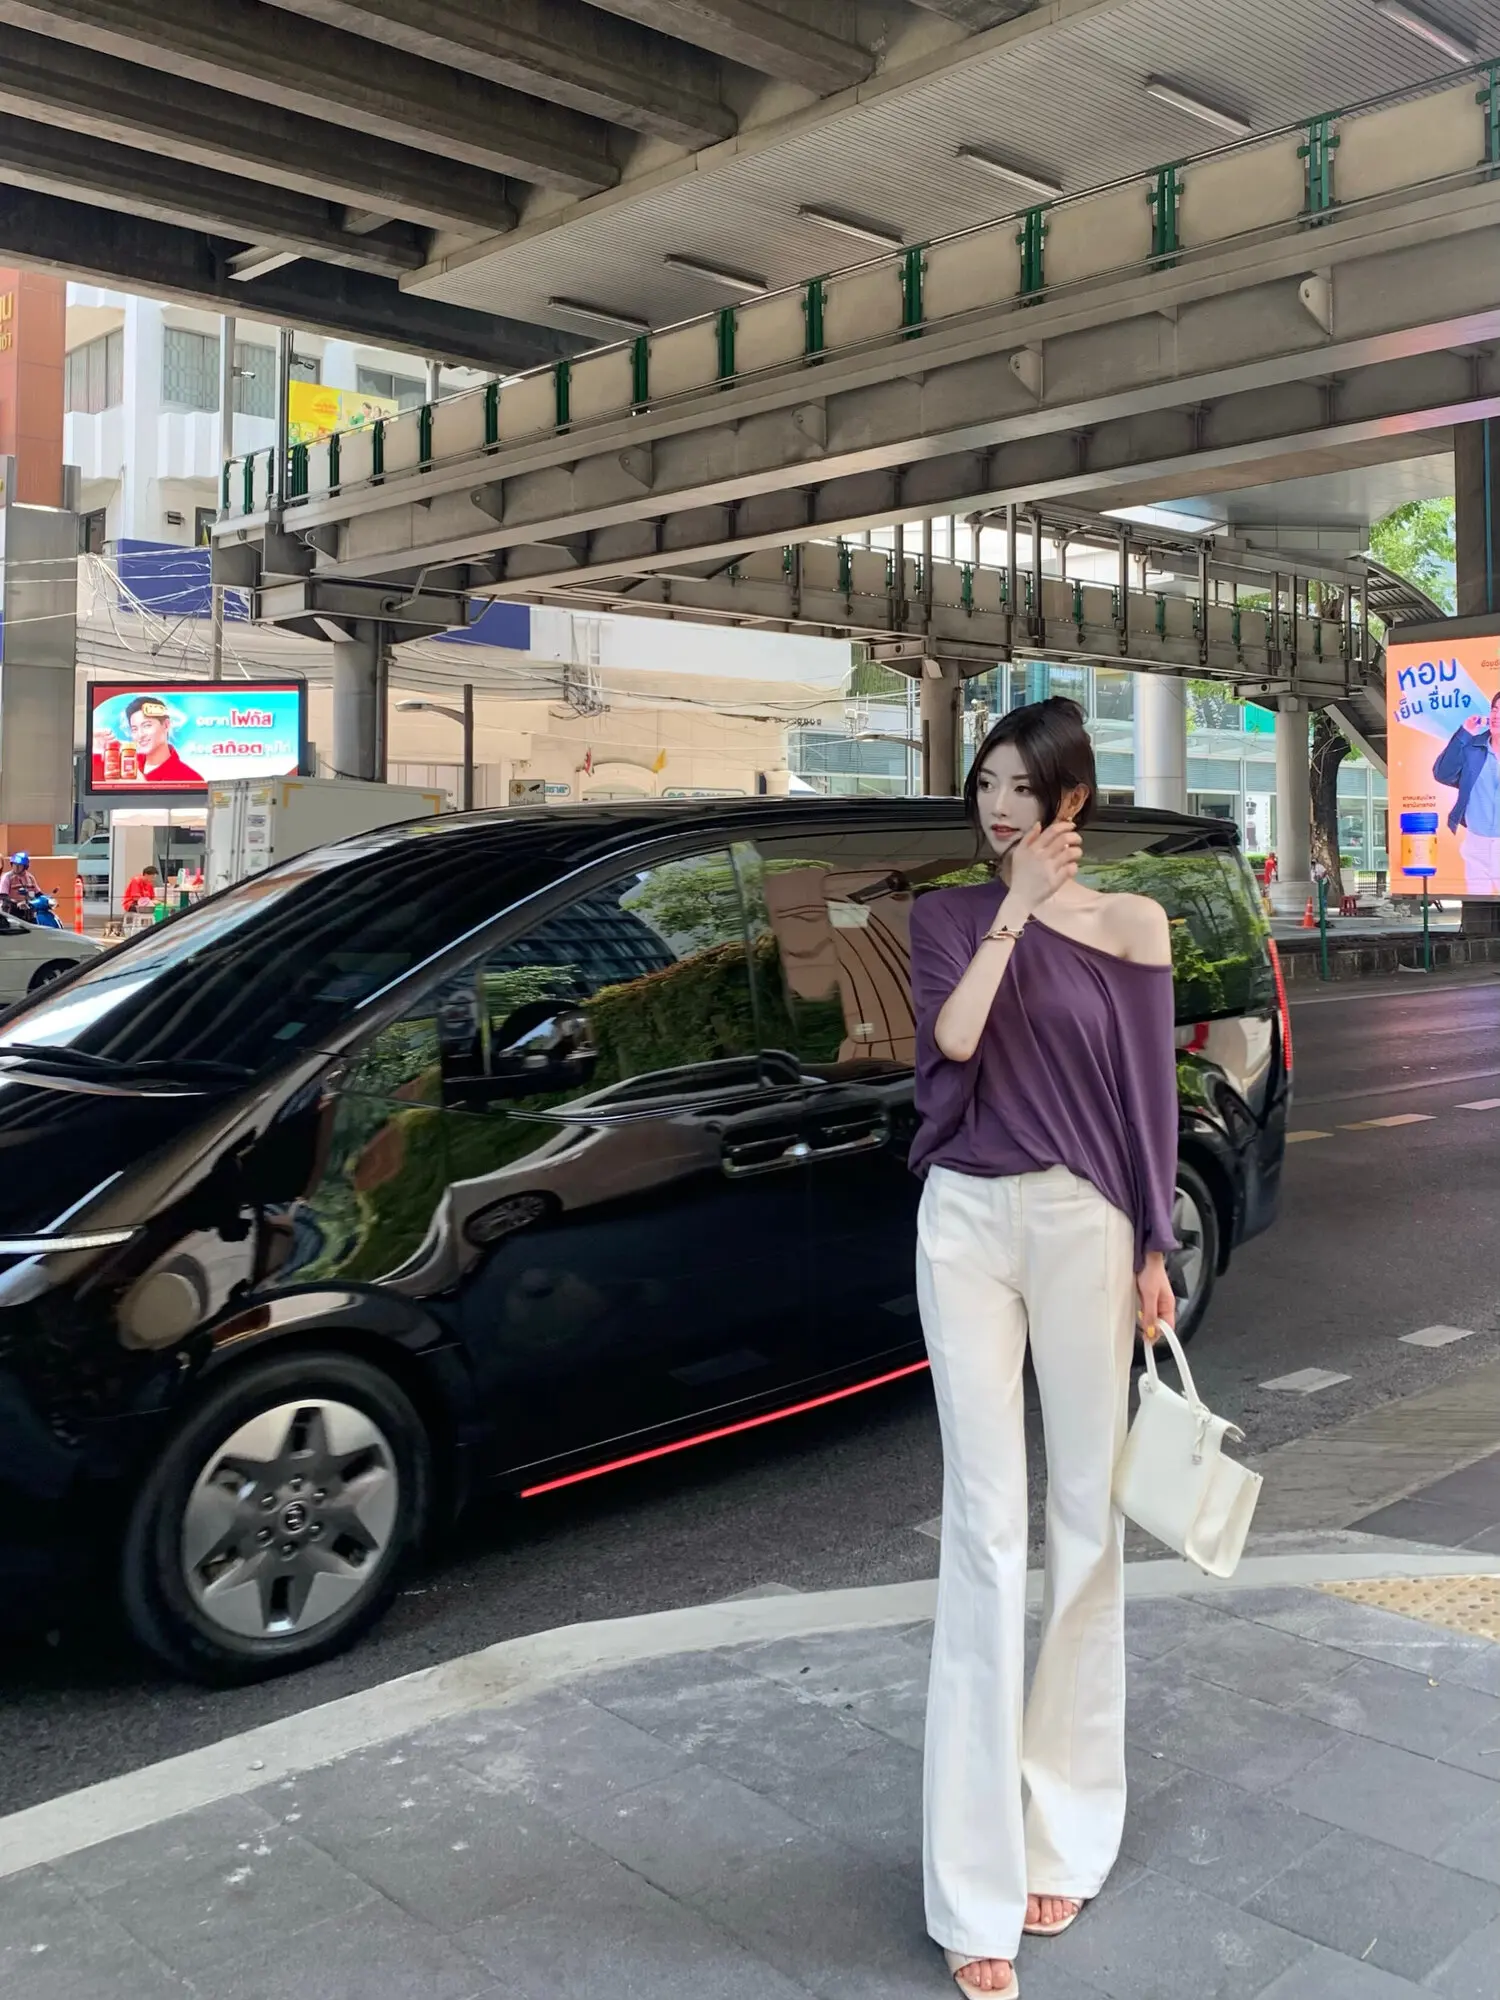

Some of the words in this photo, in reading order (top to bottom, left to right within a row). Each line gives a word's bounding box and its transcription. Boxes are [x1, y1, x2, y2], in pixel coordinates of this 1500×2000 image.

[1397, 658, 1457, 691] หอม
[1393, 698, 1424, 722] เย็น
[1428, 685, 1472, 710] ชื่นใจ
